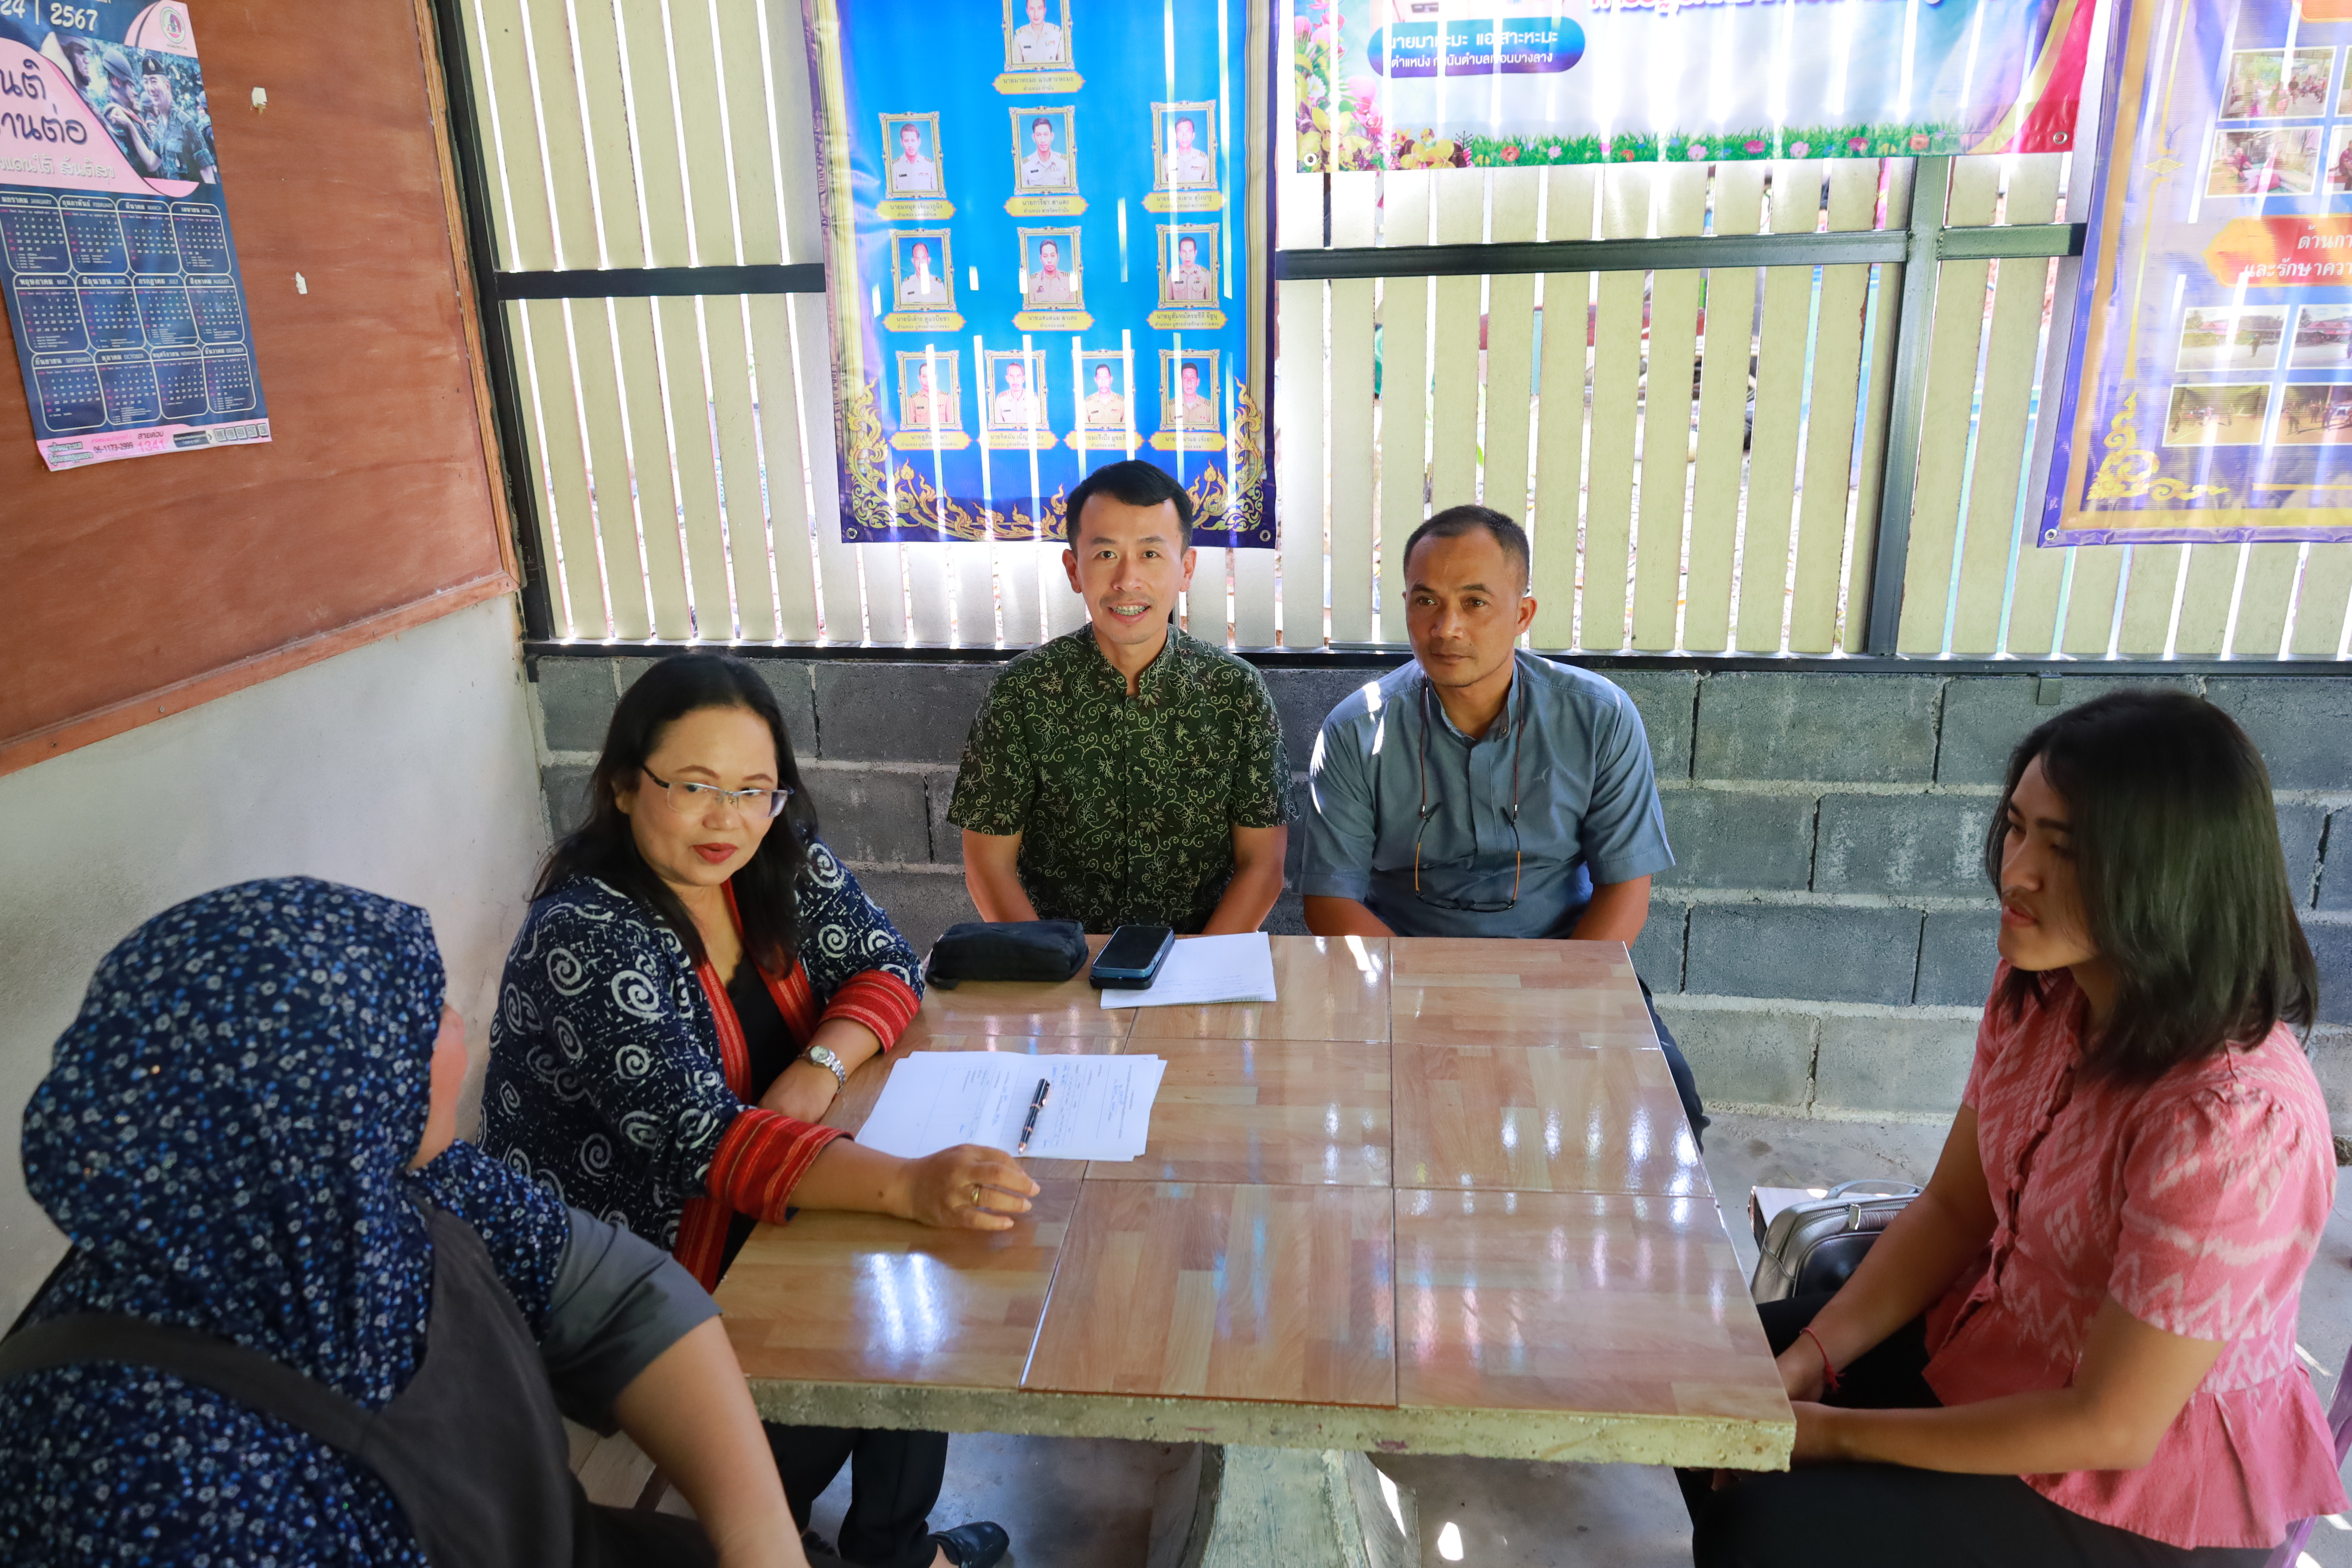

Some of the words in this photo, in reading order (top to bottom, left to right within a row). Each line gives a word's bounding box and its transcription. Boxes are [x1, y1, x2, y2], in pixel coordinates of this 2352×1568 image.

[50, 3, 98, 31] 2567
[1476, 31, 1558, 46] แอสาะหะมะ
[1392, 54, 1430, 68] ตำแหน่ง
[0, 103, 87, 145] านต่อ
[60, 155, 115, 185] สันติสุข
[138, 429, 164, 439] สายด่วน
[138, 438, 166, 452] 1341
